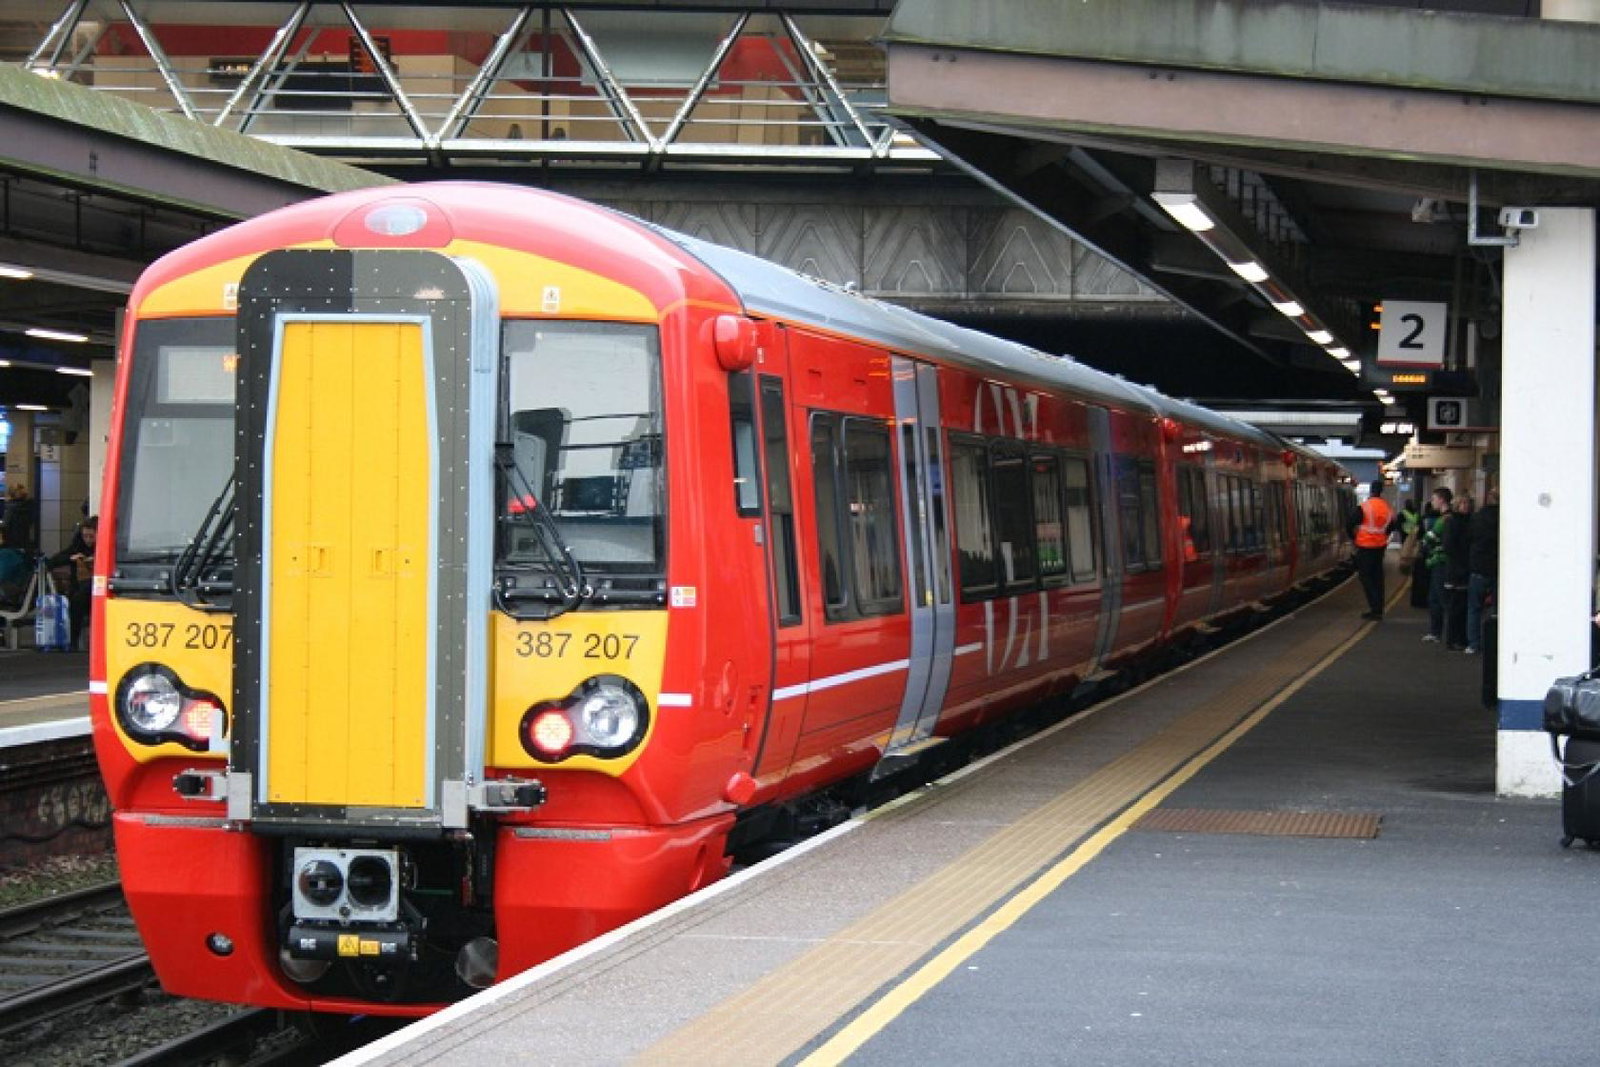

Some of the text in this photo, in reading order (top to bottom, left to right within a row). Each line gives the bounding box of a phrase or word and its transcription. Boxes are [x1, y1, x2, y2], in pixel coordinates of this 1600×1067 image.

[1399, 313, 1425, 349] 2
[126, 622, 233, 649] 387 207
[516, 631, 640, 659] 387 207
